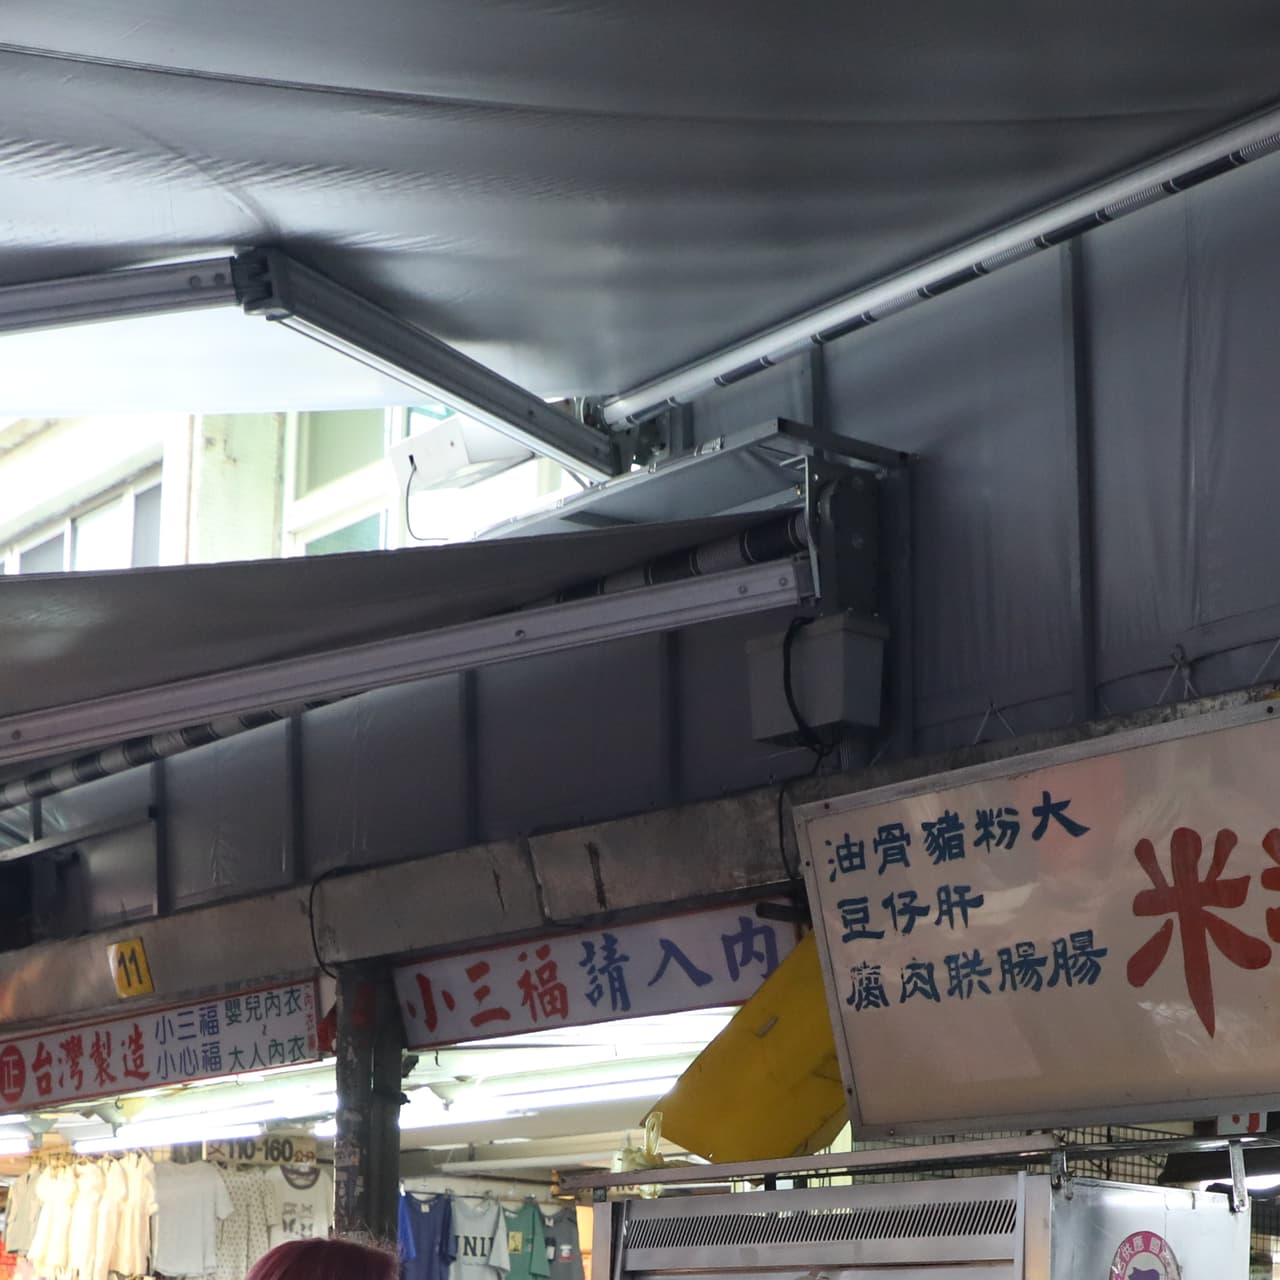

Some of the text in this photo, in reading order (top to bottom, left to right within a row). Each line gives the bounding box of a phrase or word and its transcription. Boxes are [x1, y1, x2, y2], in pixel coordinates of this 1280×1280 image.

[117, 943, 146, 988] 11
[155, 1005, 220, 1045] 小三福
[156, 1041, 223, 1081] 小心福
